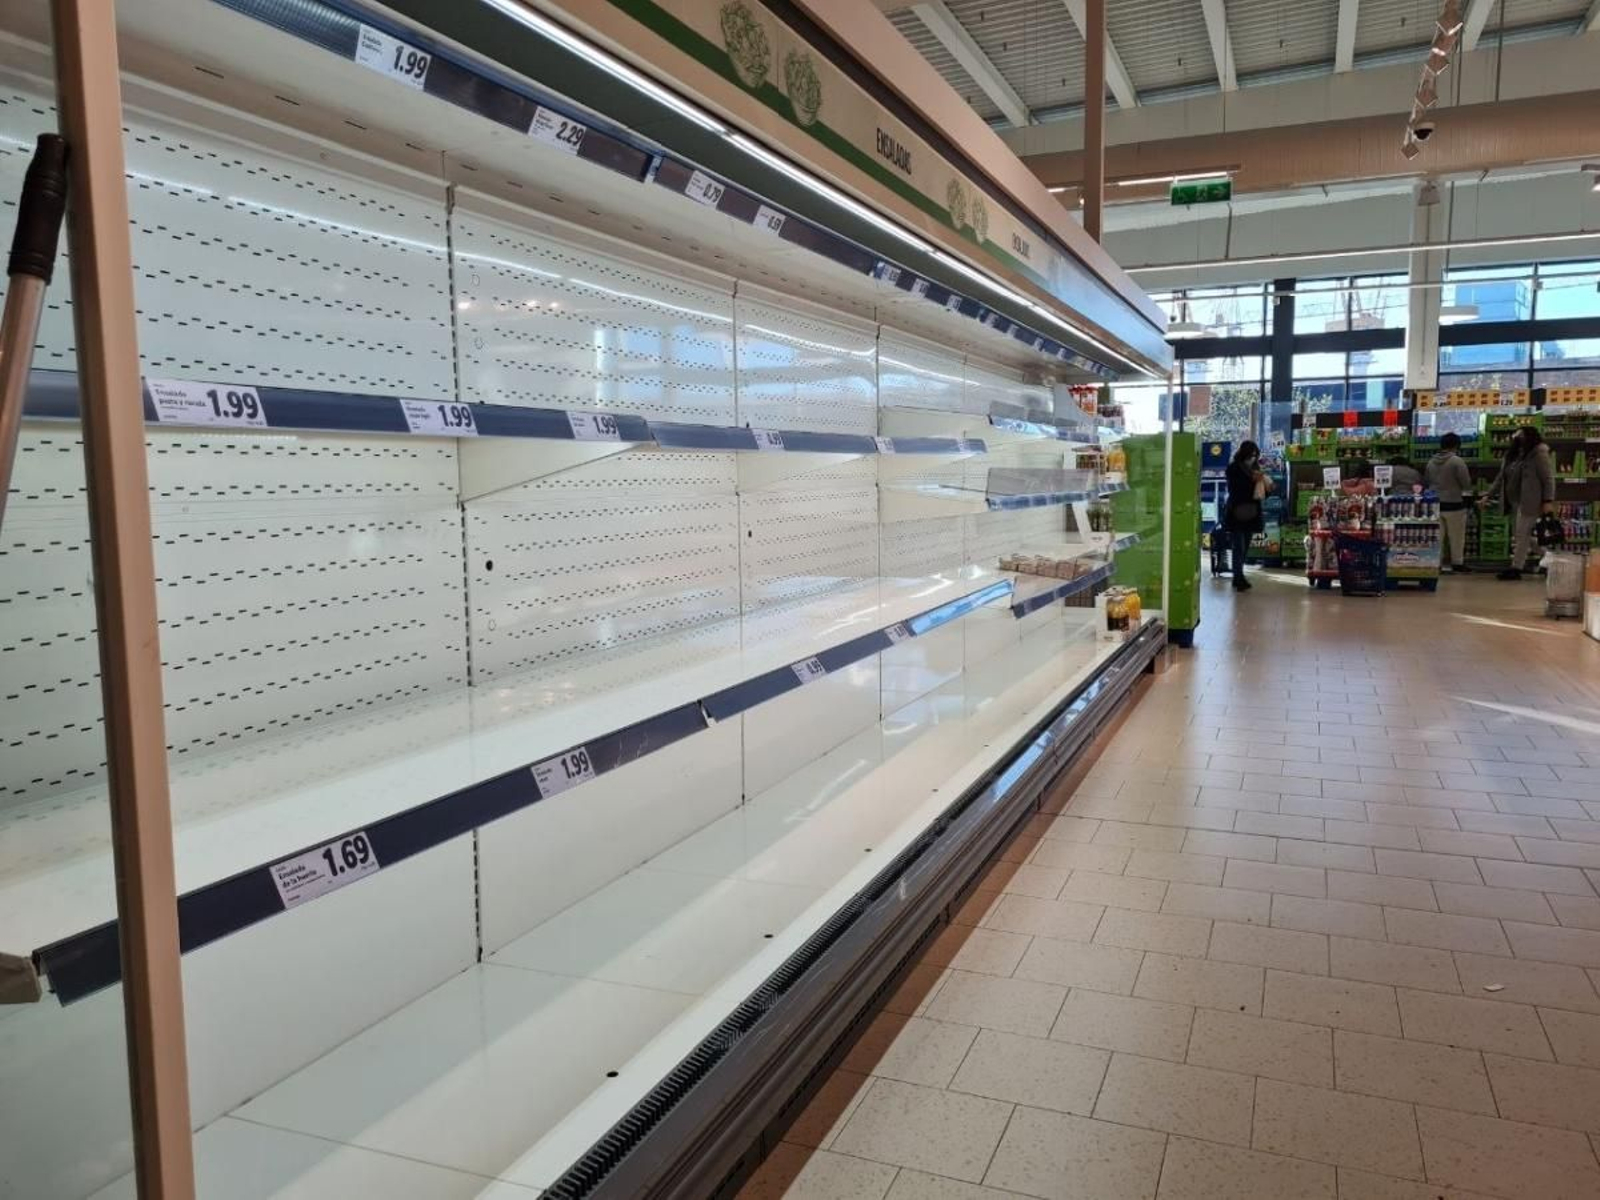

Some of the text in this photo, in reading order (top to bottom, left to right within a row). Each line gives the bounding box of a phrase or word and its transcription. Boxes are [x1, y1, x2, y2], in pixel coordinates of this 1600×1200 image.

[394, 45, 428, 79] 1.99
[556, 121, 585, 146] 2.29
[206, 389, 259, 419] 1.99
[438, 404, 472, 428] 1.99
[592, 415, 618, 435] 1.99
[561, 750, 589, 779] 1.99
[322, 835, 370, 877] 1.69
